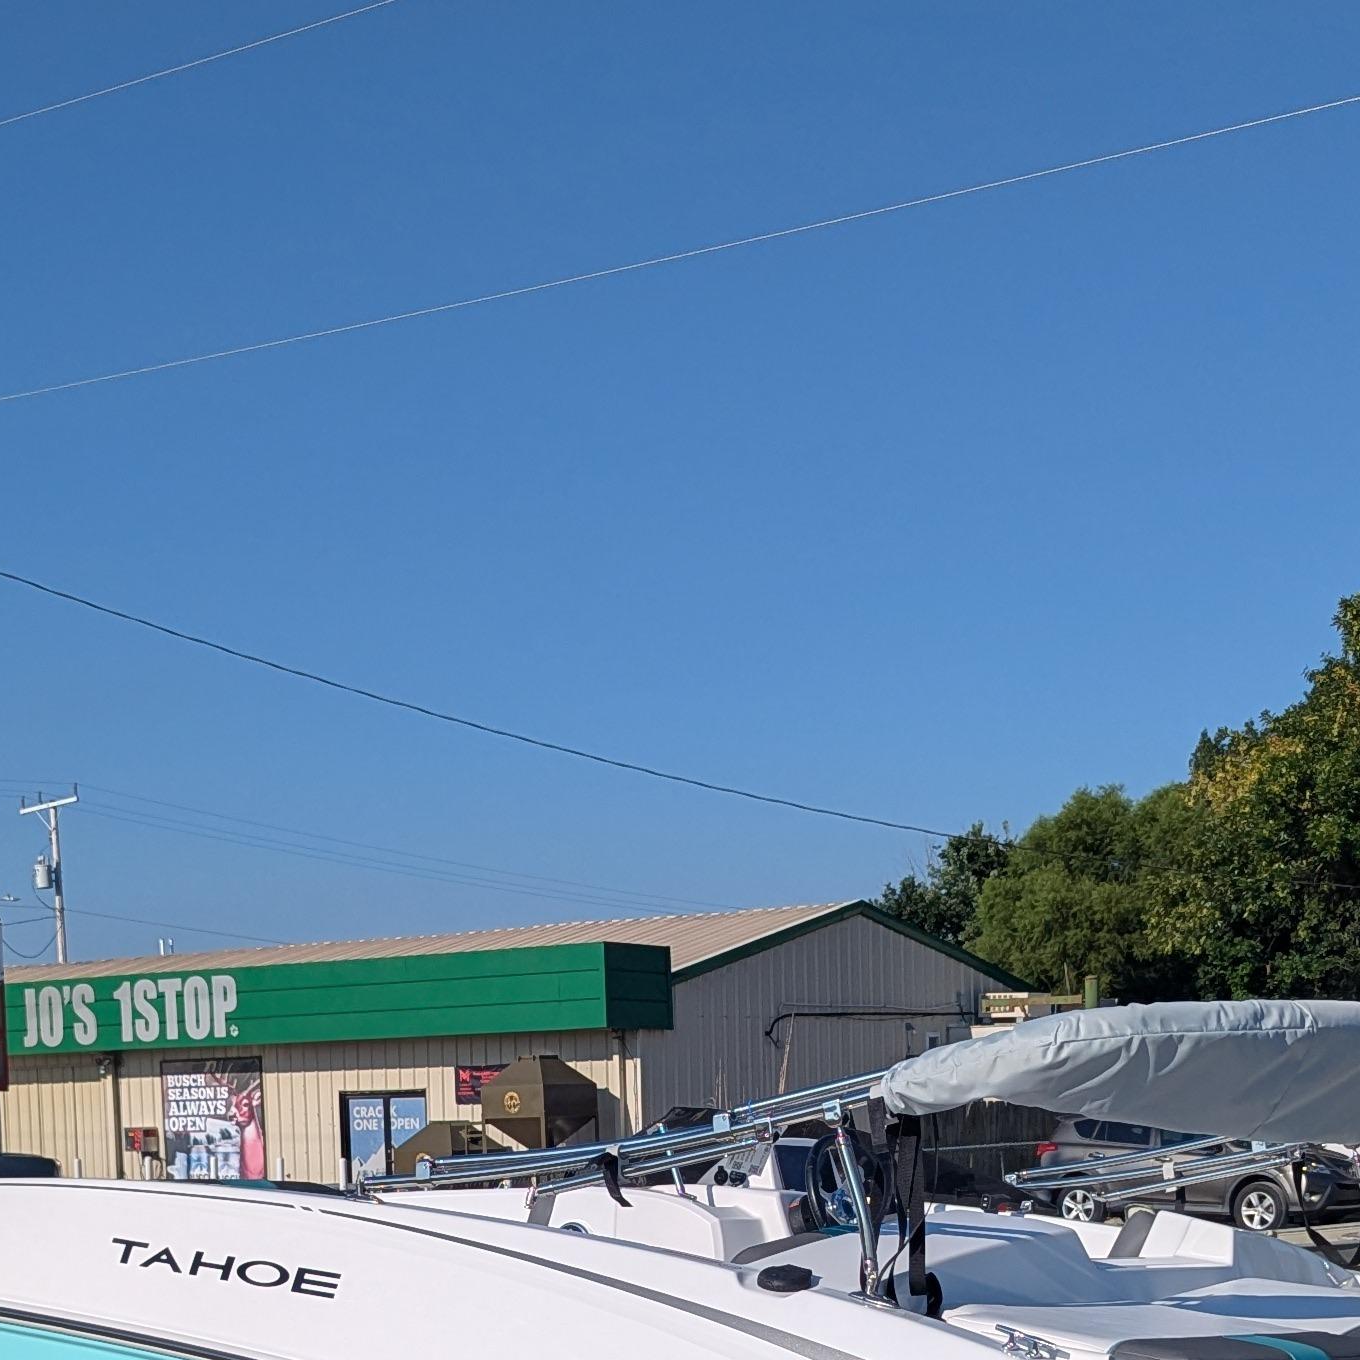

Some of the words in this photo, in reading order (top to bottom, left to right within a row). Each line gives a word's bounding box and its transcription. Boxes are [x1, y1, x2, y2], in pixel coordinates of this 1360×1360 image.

[23, 983, 98, 1048] JO'S
[167, 1074, 206, 1088] BUSCH
[168, 1088, 214, 1101] SEASON
[215, 1086, 229, 1099] IS
[168, 1100, 227, 1116] ALWAYS
[169, 1117, 207, 1132] OPEN
[353, 1118, 379, 1132] ONE
[112, 1237, 342, 1300] TAHOE
